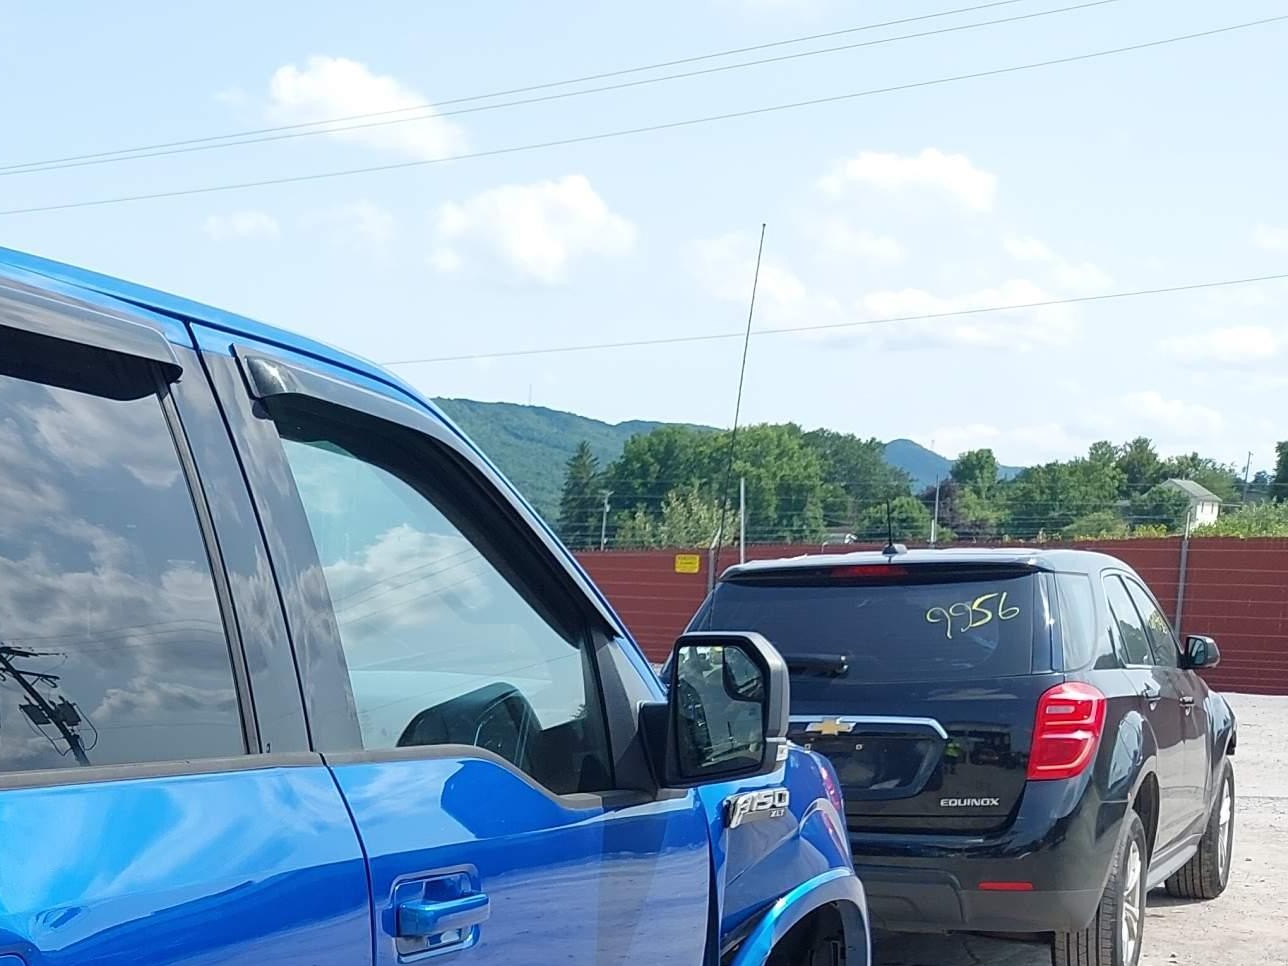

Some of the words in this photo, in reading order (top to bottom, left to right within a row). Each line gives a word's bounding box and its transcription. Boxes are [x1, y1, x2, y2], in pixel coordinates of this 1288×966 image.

[926, 591, 1020, 639] 9956
[940, 798, 1000, 807] EQUINOX
[769, 809, 785, 818] XLT
